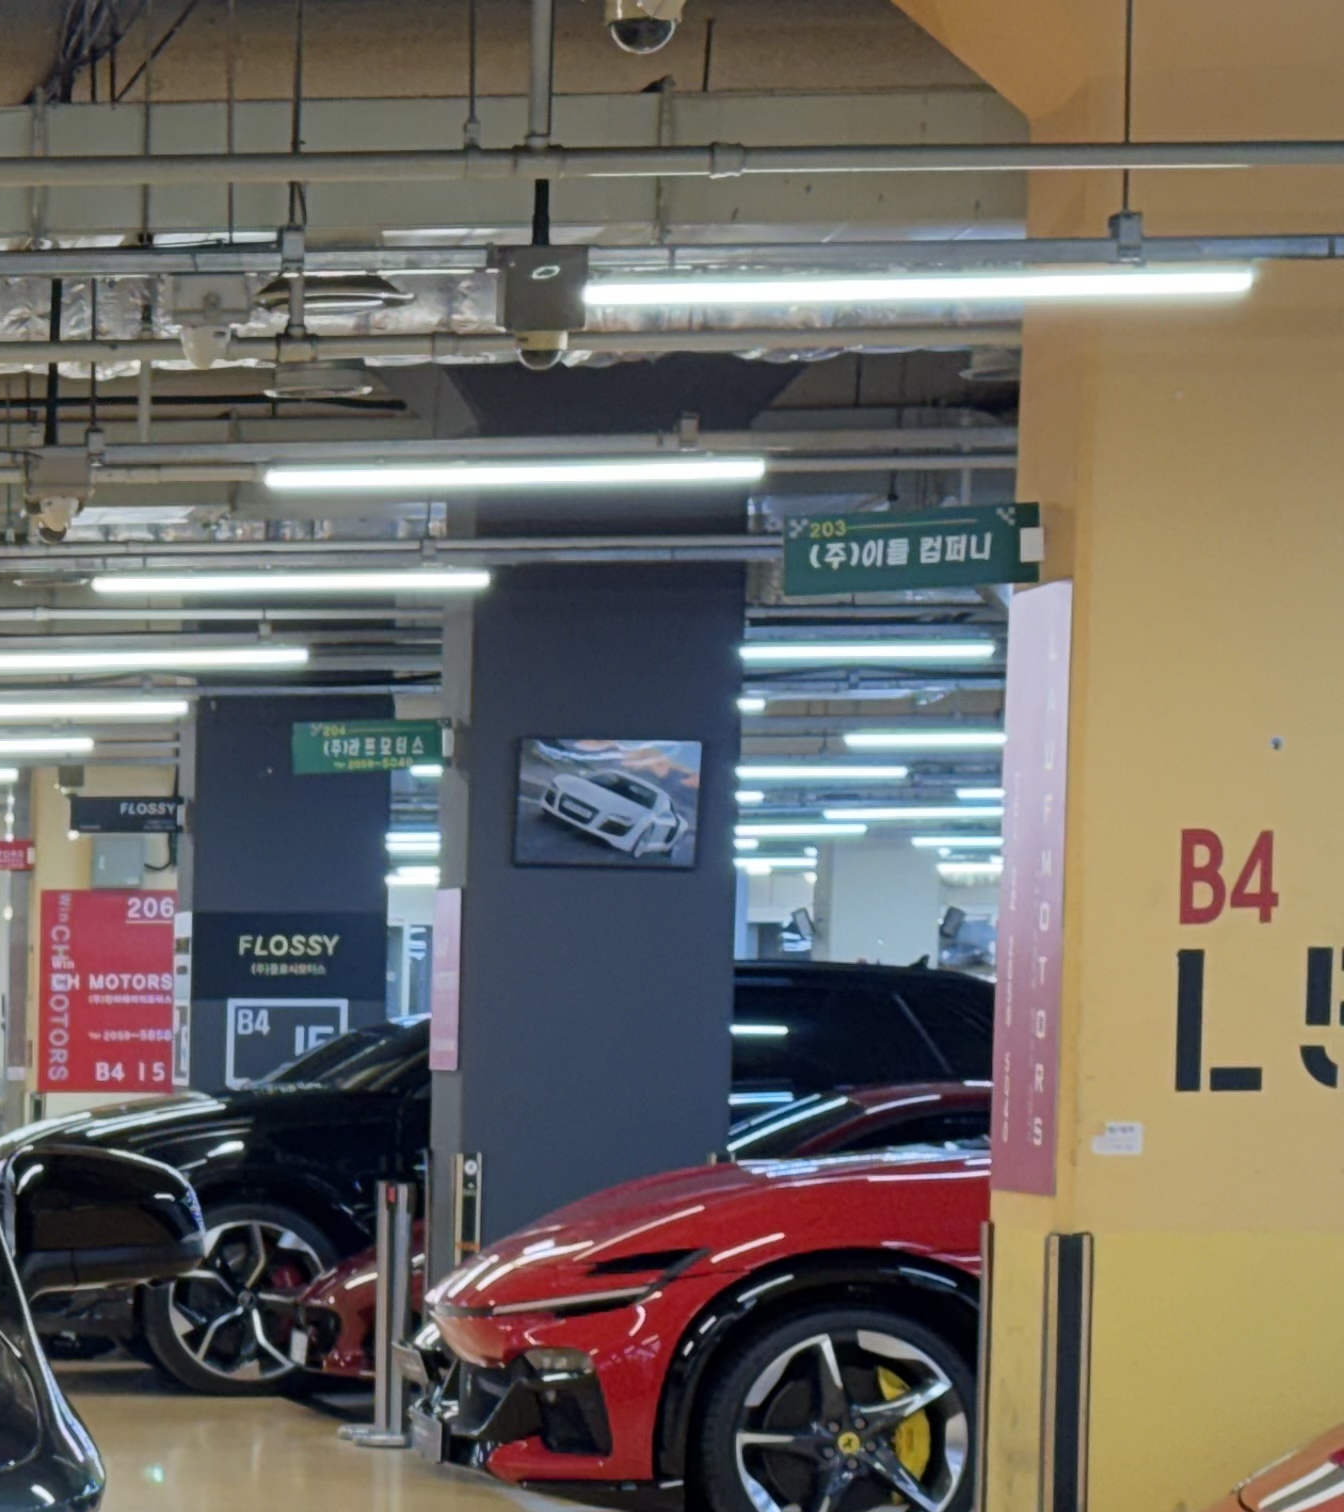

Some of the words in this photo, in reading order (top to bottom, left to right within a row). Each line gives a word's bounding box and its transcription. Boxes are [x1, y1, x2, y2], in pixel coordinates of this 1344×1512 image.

[809, 519, 847, 538] 203
[919, 531, 992, 564] 컴퍼니
[119, 802, 177, 816] FLOSSY
[1179, 828, 1279, 924] B4
[127, 897, 175, 918] 206
[238, 934, 340, 956] FLOSSY
[88, 973, 173, 990] MOTORS
[237, 1008, 270, 1036] B4
[95, 1061, 125, 1081] B4
